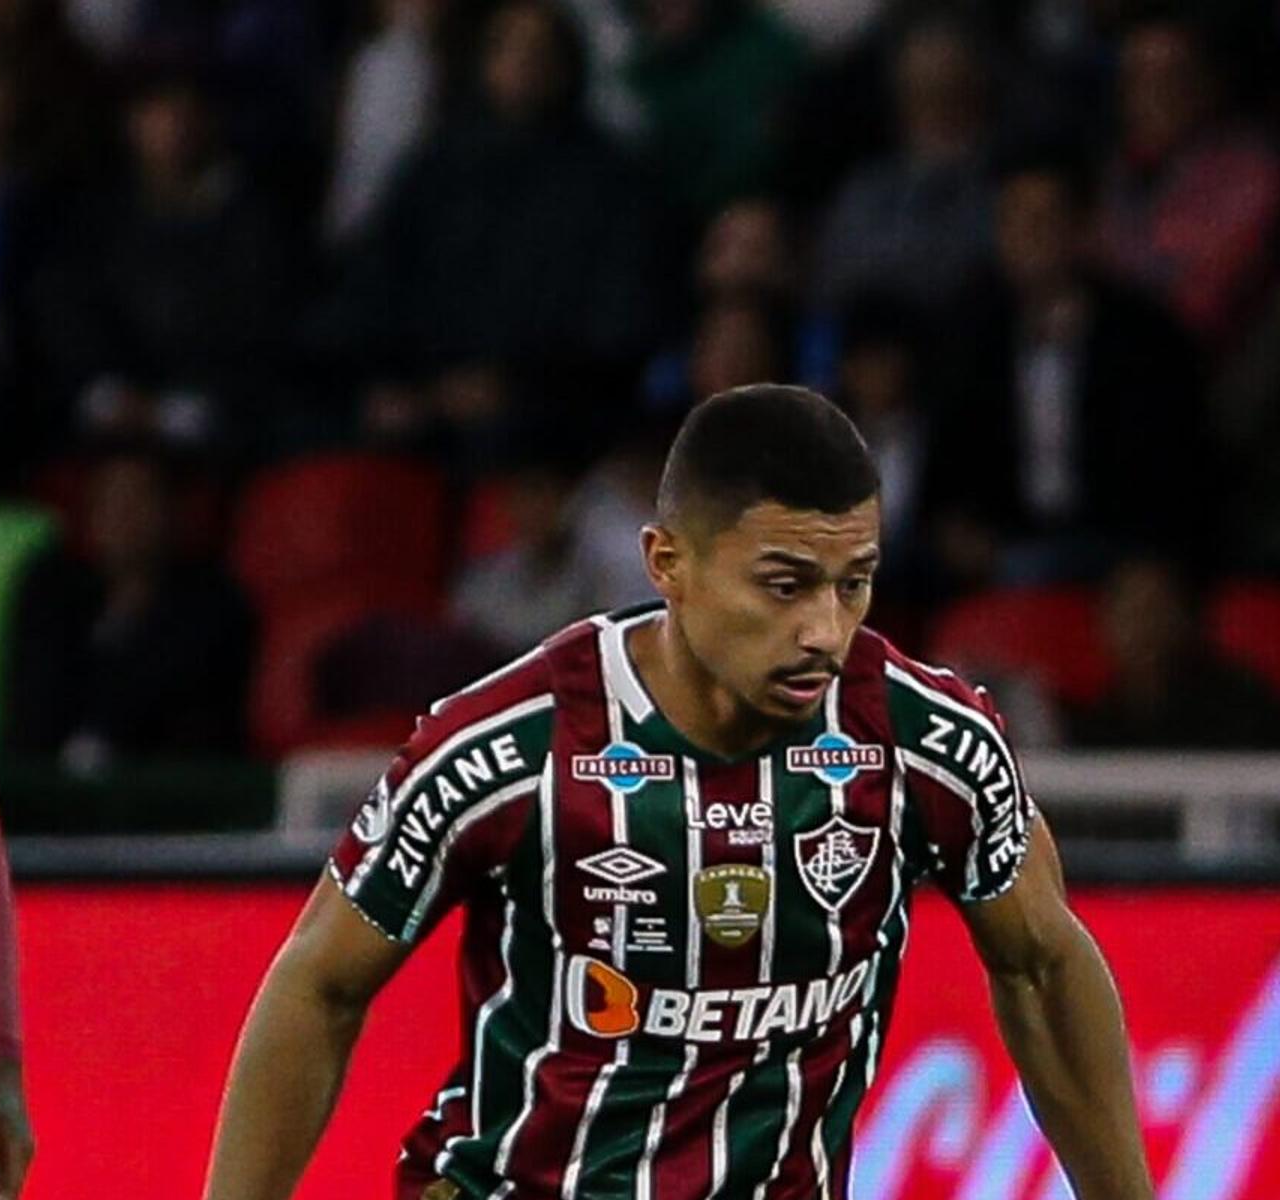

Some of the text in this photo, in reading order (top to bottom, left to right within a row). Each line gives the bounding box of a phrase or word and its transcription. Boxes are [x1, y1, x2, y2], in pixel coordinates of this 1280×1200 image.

[688, 802, 773, 829] Leve
[583, 886, 657, 904] umbro
[643, 959, 869, 1041] BETANO
